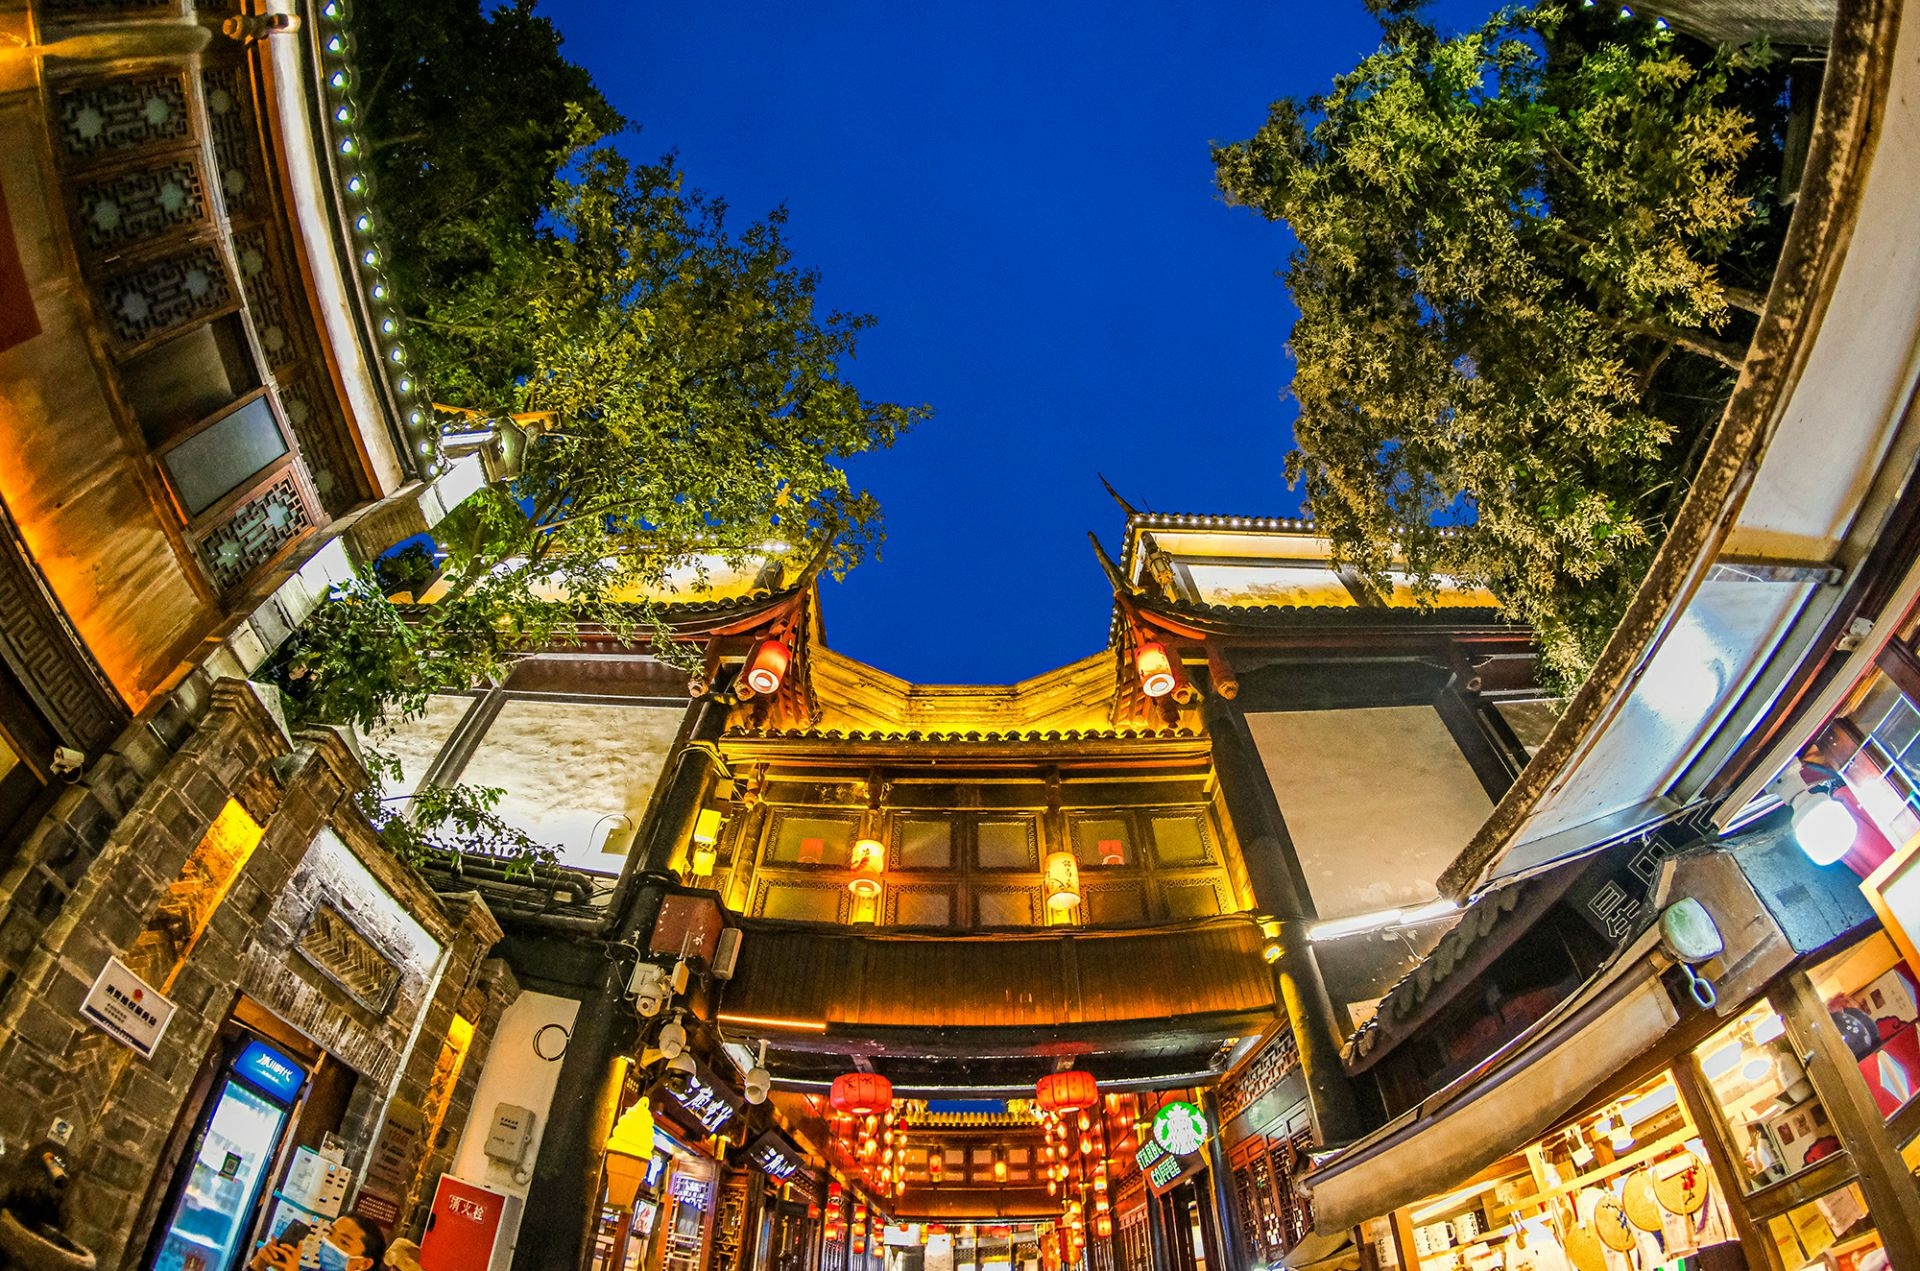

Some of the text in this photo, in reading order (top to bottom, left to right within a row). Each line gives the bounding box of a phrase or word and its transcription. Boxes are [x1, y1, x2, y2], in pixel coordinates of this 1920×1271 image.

[1150, 1154, 1182, 1188] COFFEE
[447, 1194, 486, 1223] 消火栓
